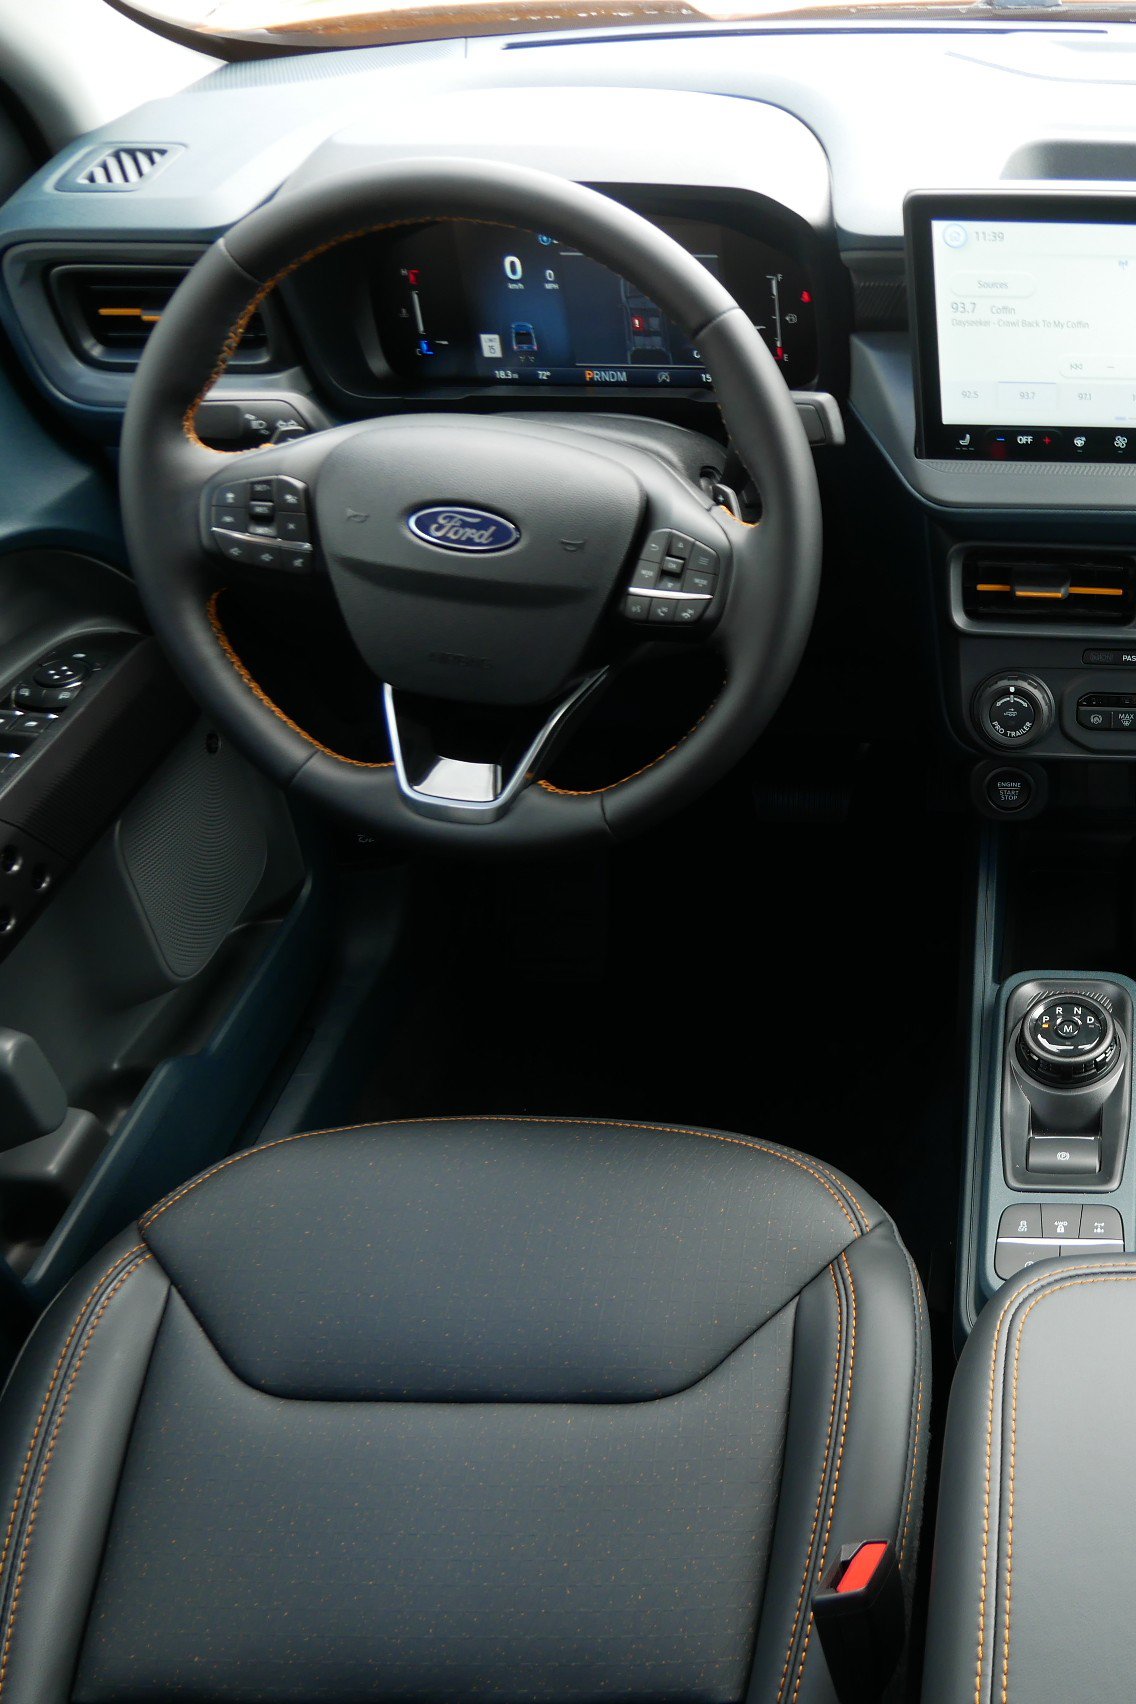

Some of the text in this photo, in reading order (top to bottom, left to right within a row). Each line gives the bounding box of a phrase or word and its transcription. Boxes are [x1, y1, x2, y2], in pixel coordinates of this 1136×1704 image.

[974, 231, 1005, 242] 11:39
[504, 256, 522, 280] 0
[545, 270, 555, 281] 0
[977, 279, 1009, 289] Sources
[951, 302, 1016, 316] 93.7 Coffin
[951, 319, 991, 329] Dayseeker
[997, 319, 1020, 328] Crawl
[1021, 320, 1040, 328] Back
[1042, 320, 1052, 329] To
[1052, 320, 1065, 330] My
[1066, 320, 1090, 329] Coffin
[585, 370, 627, 382] PRNDM
[961, 391, 979, 399] 92.5
[1019, 392, 1035, 400] 93.7
[1078, 393, 1092, 401] 97.1
[1017, 435, 1033, 445] OFF
[429, 513, 497, 544] Ford
[992, 720, 1033, 738] PRO TRAILER
